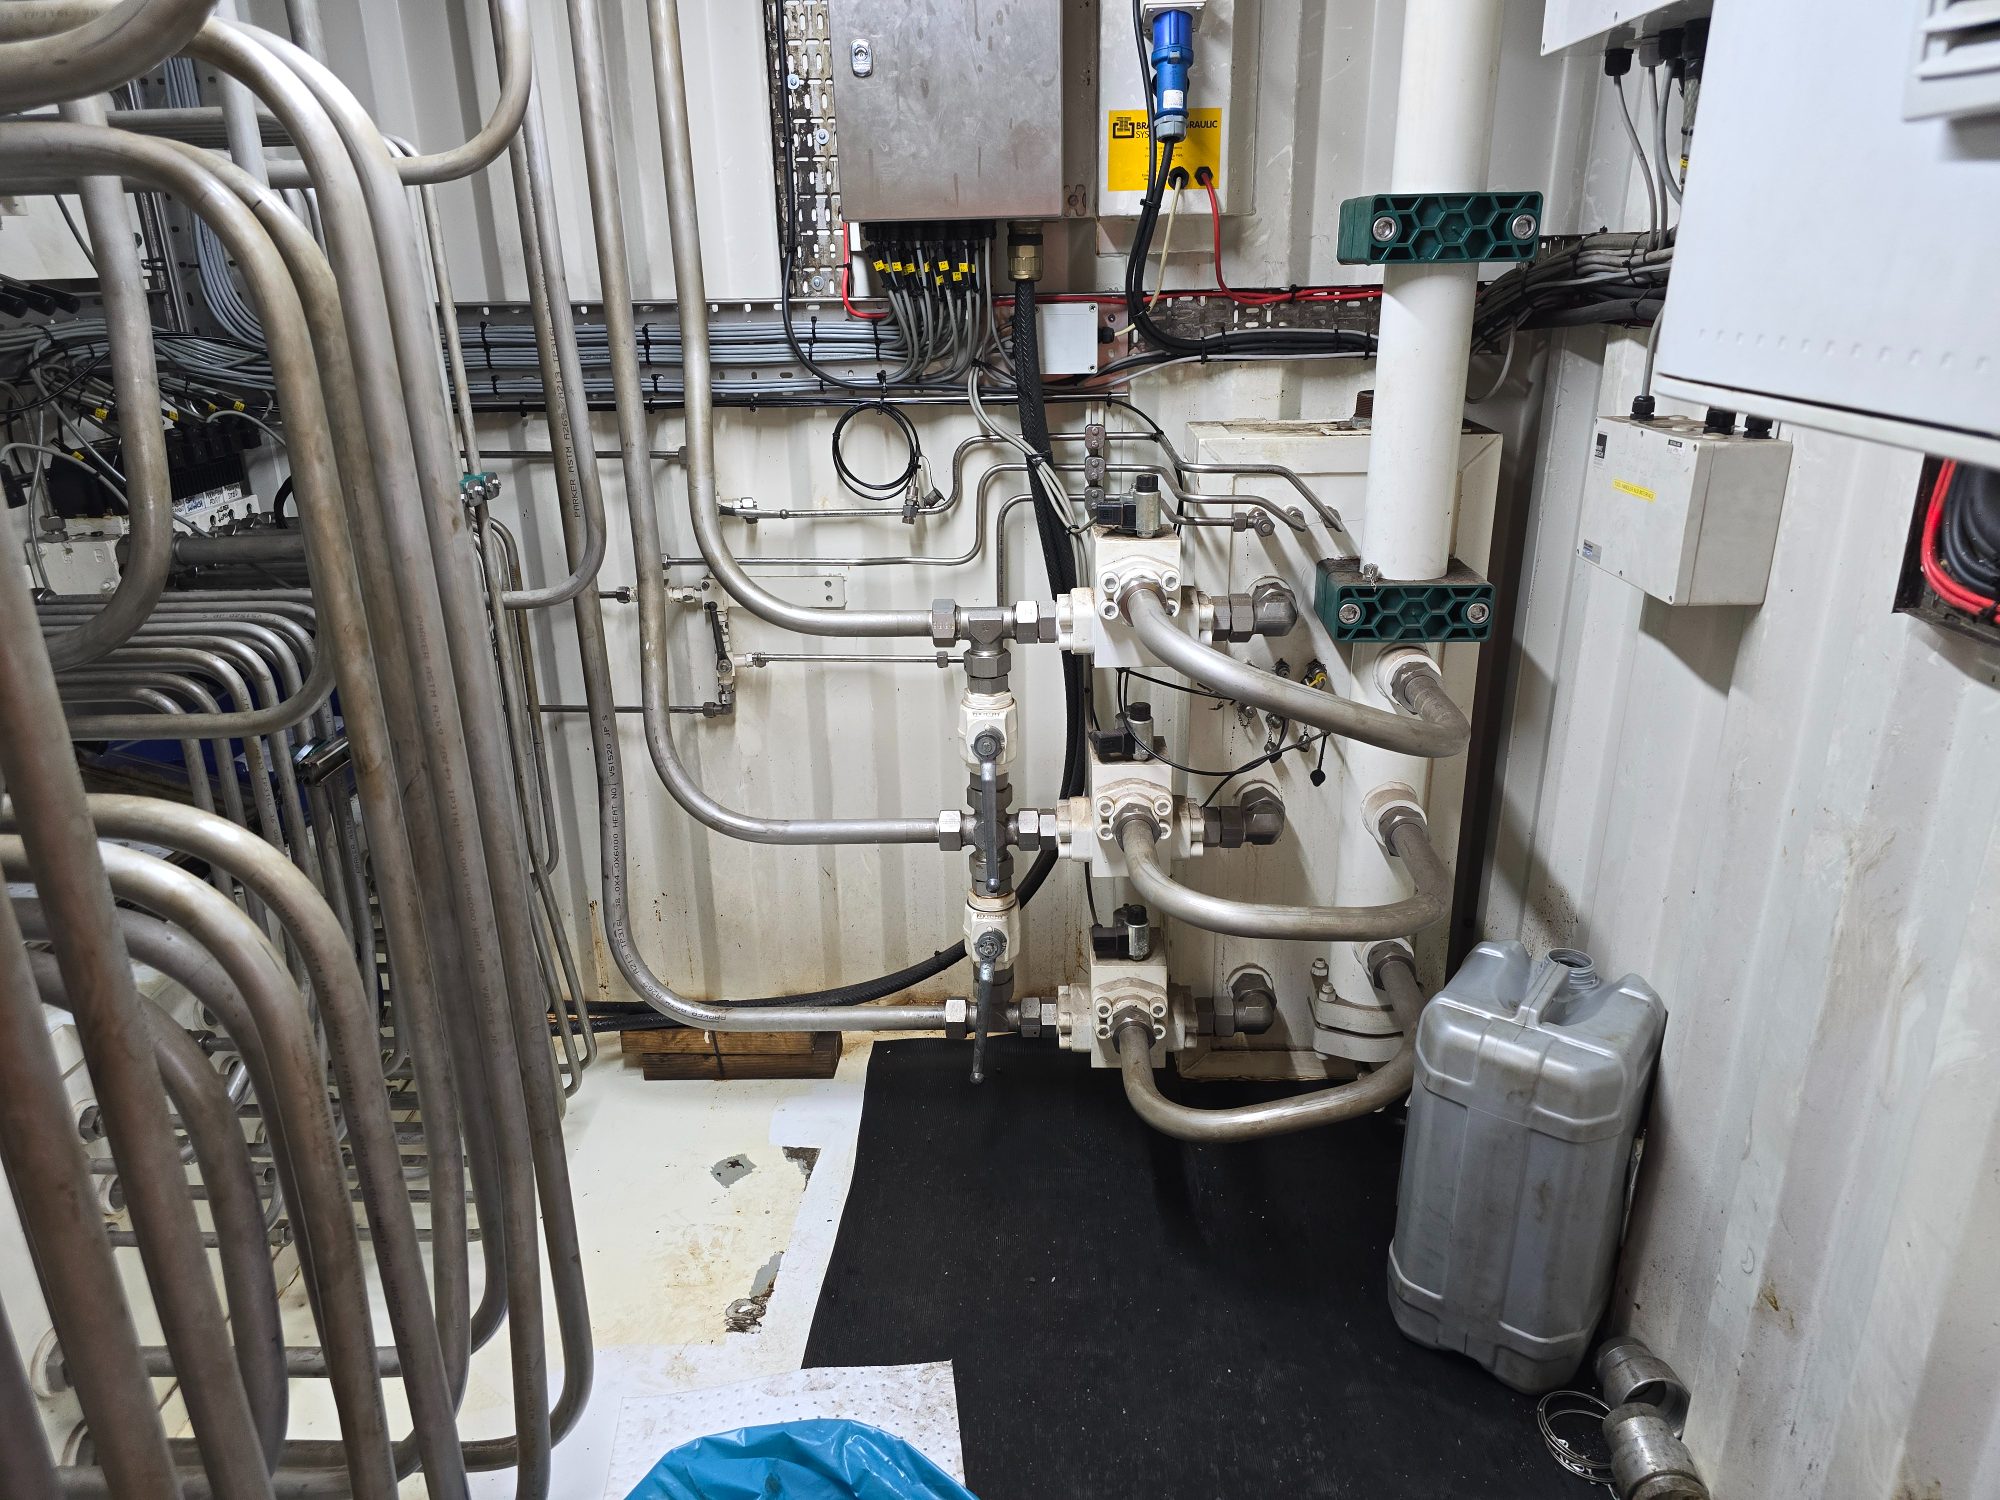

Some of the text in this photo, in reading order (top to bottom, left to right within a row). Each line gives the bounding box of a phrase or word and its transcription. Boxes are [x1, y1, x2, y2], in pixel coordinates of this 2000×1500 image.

[566, 446, 575, 473] ASTM
[572, 479, 581, 519] PARKER
[602, 713, 608, 721] S
[604, 725, 611, 738] JP
[607, 743, 616, 777] V51520
[611, 787, 617, 799] NO
[616, 918, 627, 949] TP316L
